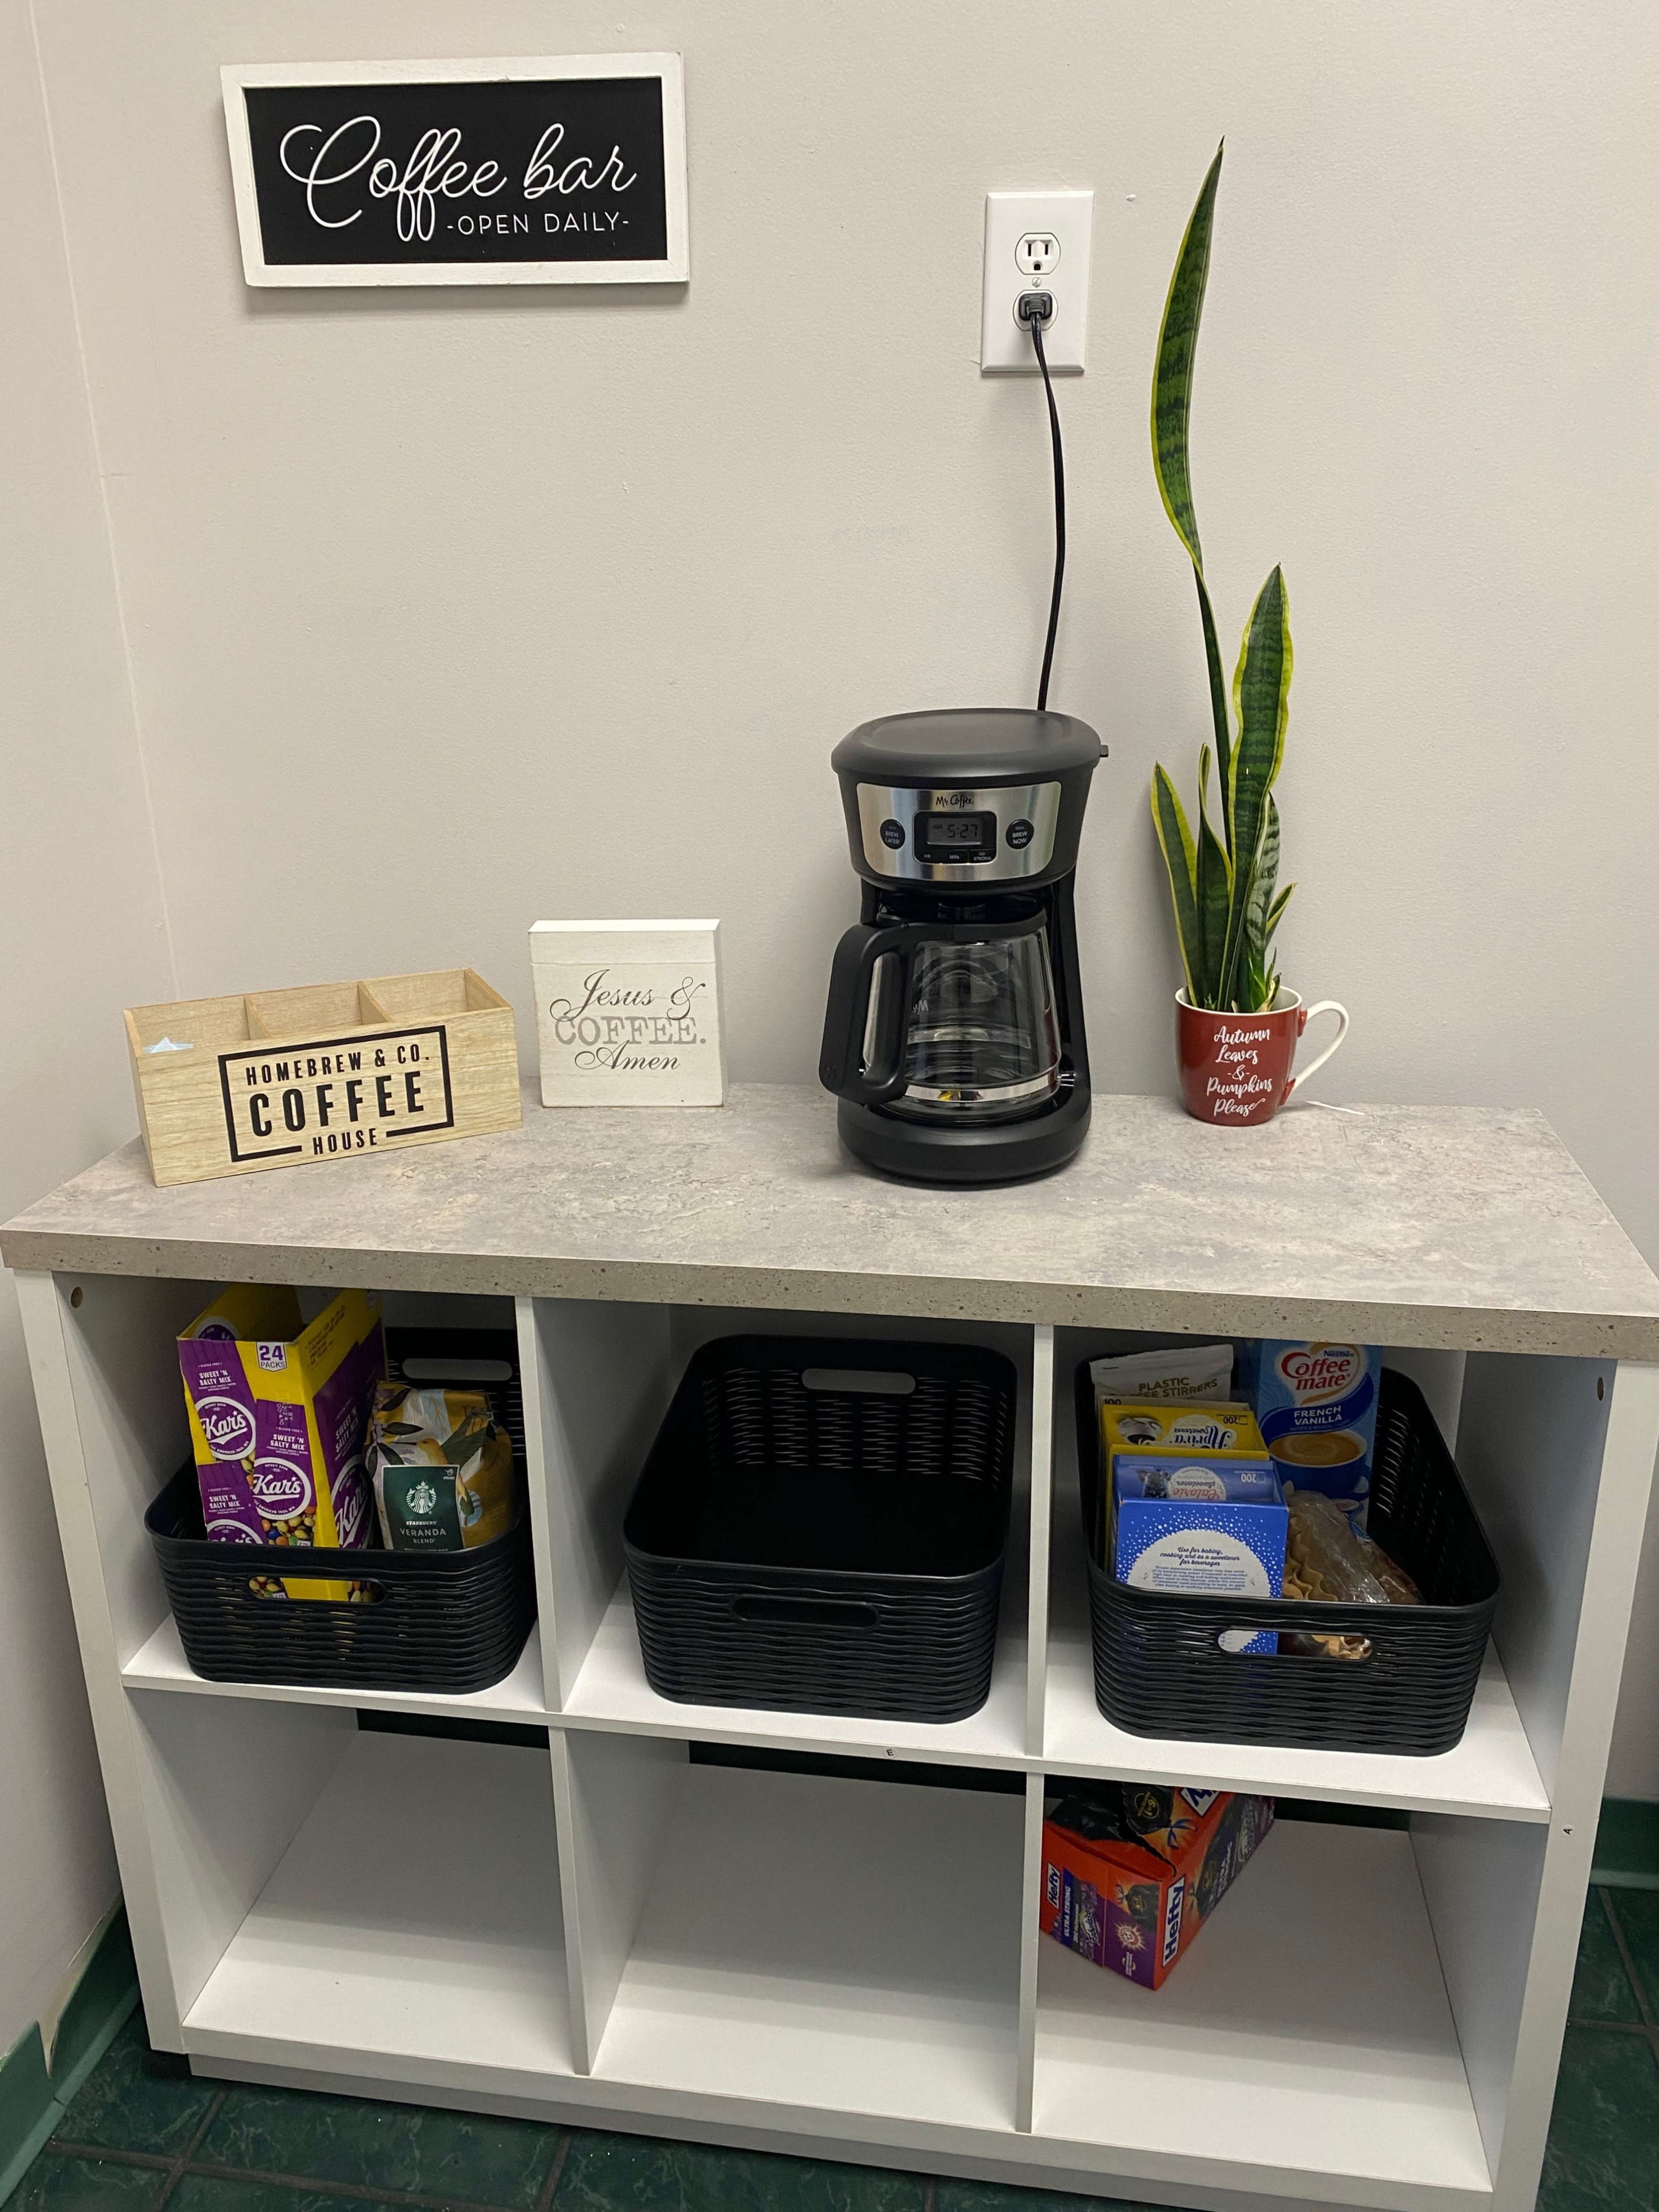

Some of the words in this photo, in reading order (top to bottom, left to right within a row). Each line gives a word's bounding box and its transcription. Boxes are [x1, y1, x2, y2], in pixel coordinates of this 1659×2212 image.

[280, 115, 507, 242] Coffee
[522, 123, 638, 200] bar
[935, 796, 949, 806] Mr.
[950, 794, 975, 808] Coffee
[947, 824, 978, 838] 5:27
[550, 969, 655, 1022] Jesus
[667, 976, 706, 1020] &
[555, 1015, 706, 1046] COFFEE.
[1214, 1026, 1270, 1045] Autumn
[575, 1039, 680, 1070] Amen
[1215, 1045, 1258, 1064] Leaves
[246, 1052, 361, 1086] HOMEBREW
[375, 1049, 386, 1066] &
[397, 1043, 430, 1064] CO.
[1207, 1074, 1272, 1099] Pumpkins
[249, 1071, 424, 1137] COFFEE
[1213, 1098, 1266, 1117] Please
[313, 1128, 378, 1155] HOUSE
[259, 1345, 283, 1361] 24
[199, 1370, 219, 1379] SWEET
[1281, 1352, 1351, 1378] Coffee
[199, 1378, 217, 1386] SALTY
[1139, 1377, 1189, 1392] PLASTIC
[1162, 1379, 1218, 1398] STIRRERS
[1296, 1374, 1345, 1390] mate
[1224, 1416, 1238, 1424] 200
[1294, 1405, 1341, 1417] FRENCH
[1294, 1414, 1342, 1425] VANILLA
[270, 1440, 289, 1449] SALTY
[273, 1433, 296, 1443] SWEET
[252, 1474, 301, 1495] Kar's
[1241, 1473, 1257, 1483] 200
[1173, 1488, 1220, 1499] Calorie
[400, 1528, 446, 1536] VERANDA
[1048, 1867, 1060, 1906] Hefty
[1164, 1886, 1184, 1962] Hefty
